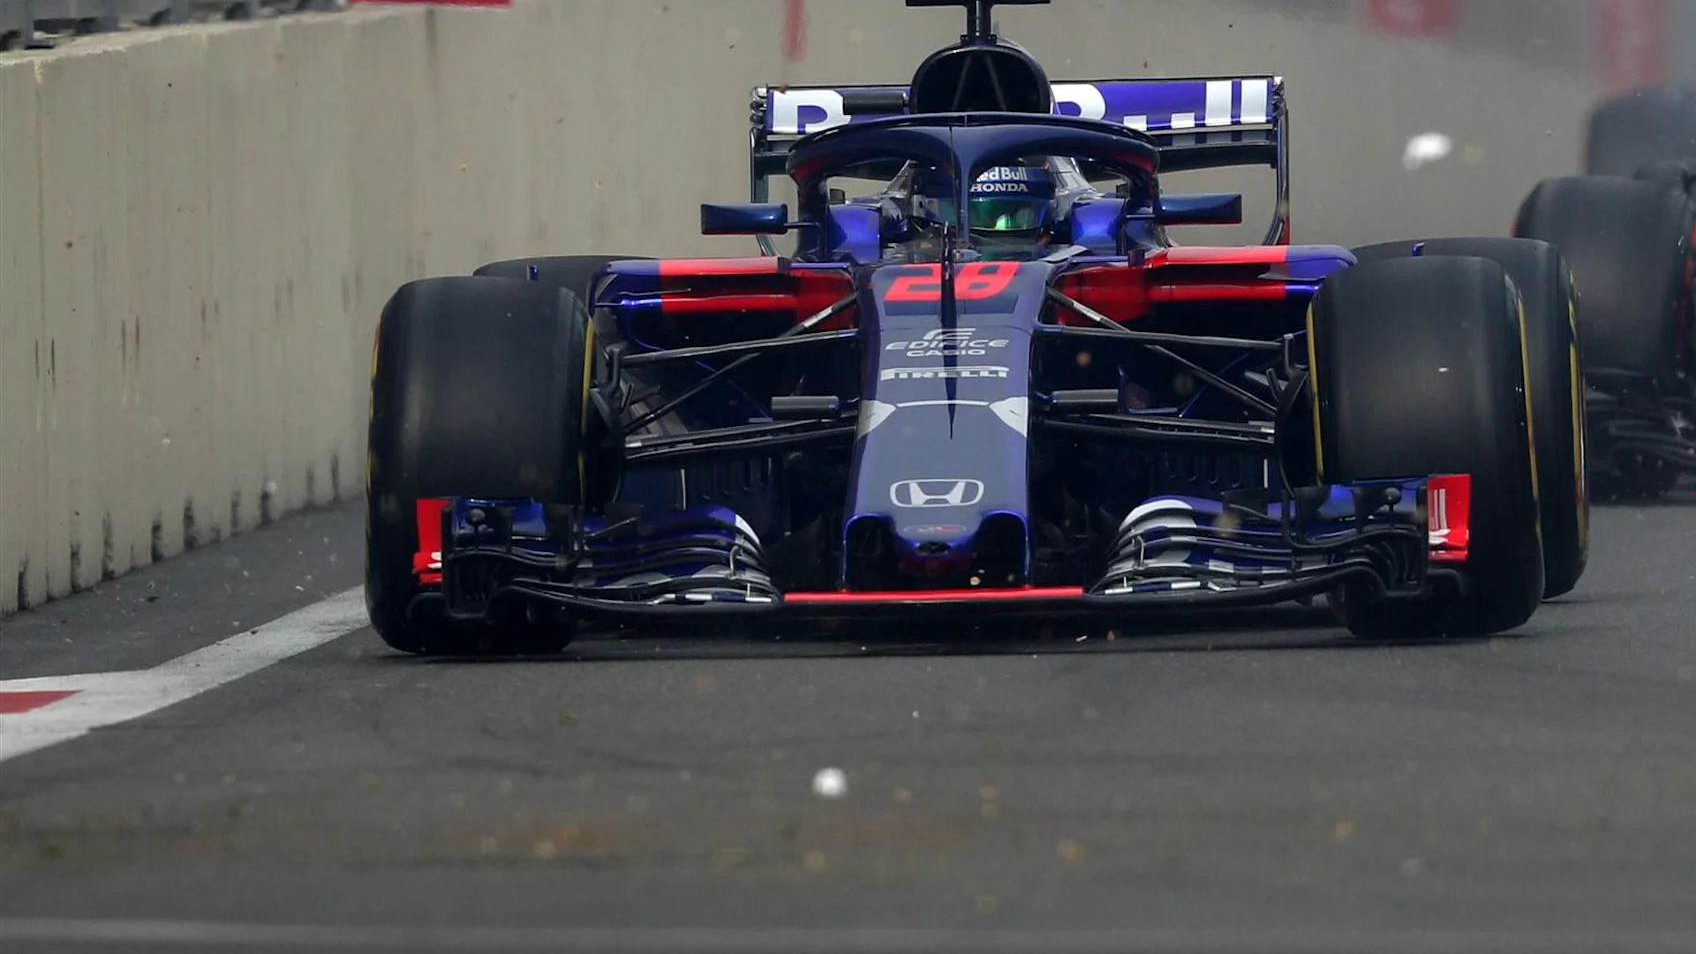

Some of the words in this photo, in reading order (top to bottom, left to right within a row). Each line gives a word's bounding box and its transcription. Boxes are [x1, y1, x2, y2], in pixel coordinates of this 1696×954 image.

[977, 167, 999, 182] ed
[1001, 167, 1028, 181] Bull
[969, 183, 1028, 192] HONDA
[884, 261, 1021, 302] 28
[880, 366, 1010, 381] PIRELLI
